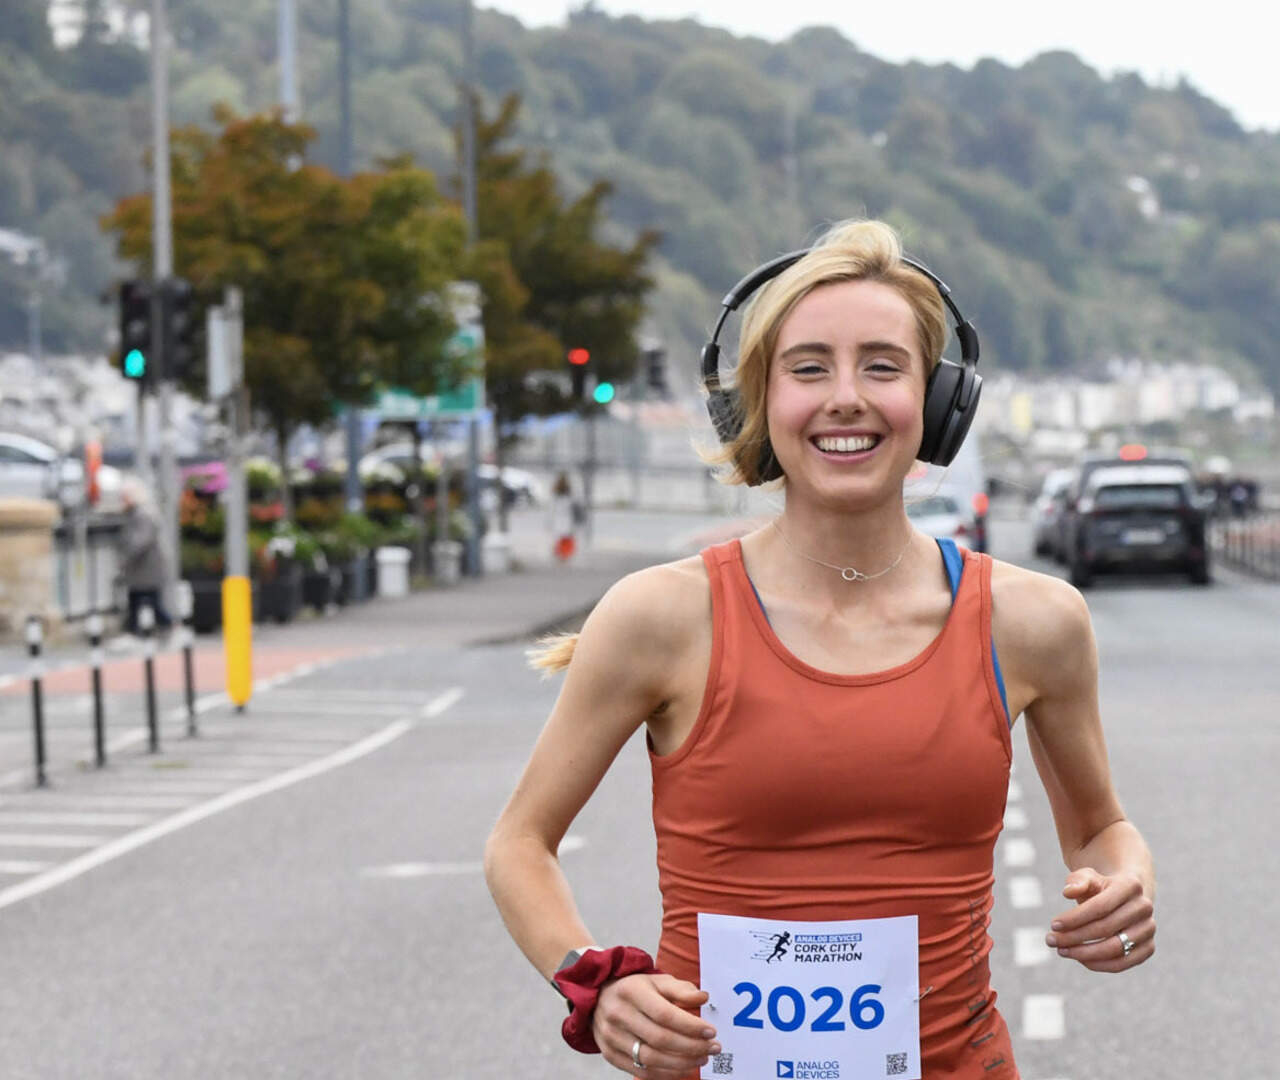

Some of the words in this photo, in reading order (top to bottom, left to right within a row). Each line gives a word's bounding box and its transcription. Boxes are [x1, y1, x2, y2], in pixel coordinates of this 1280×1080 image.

[794, 943, 827, 953] CORK
[829, 943, 858, 953] CITY
[794, 952, 862, 963] MARATHON
[732, 981, 885, 1032] 2026
[796, 1061, 839, 1070] ANALOG
[796, 1070, 840, 1080] DEVICES
